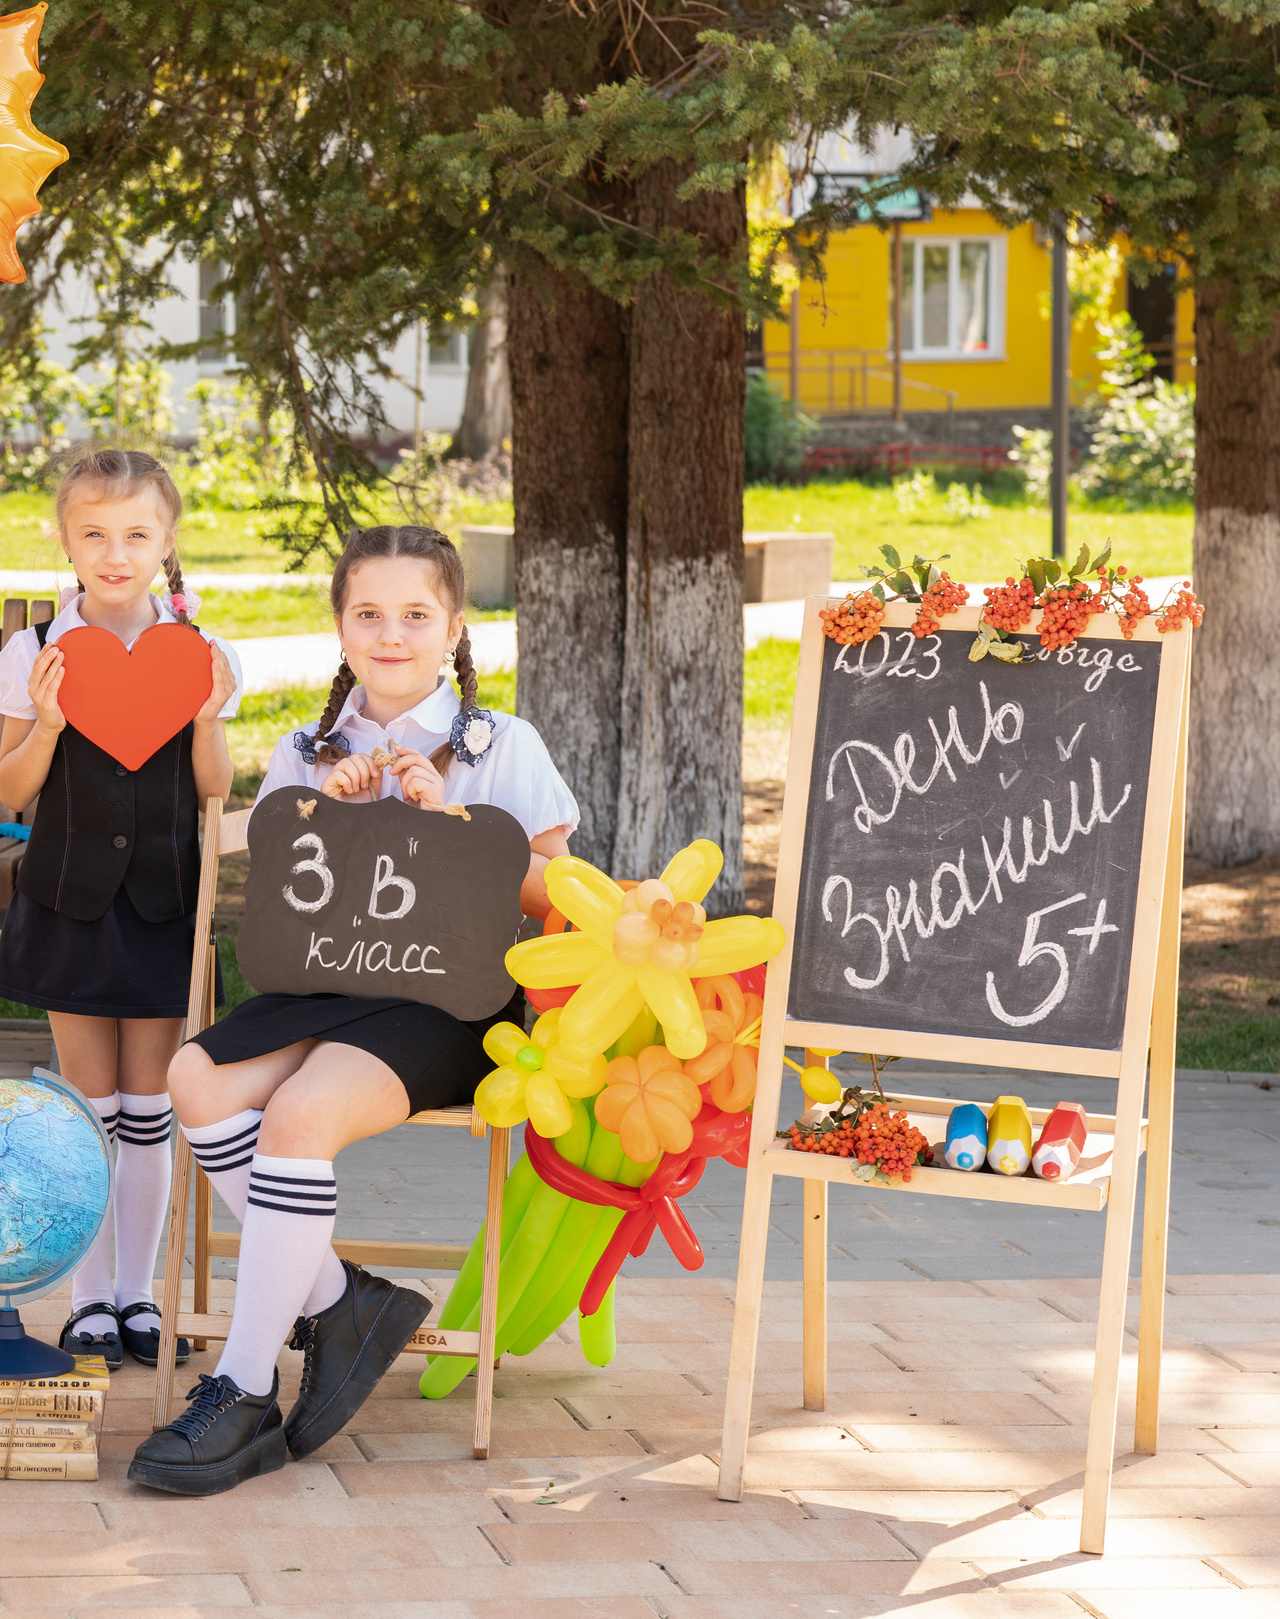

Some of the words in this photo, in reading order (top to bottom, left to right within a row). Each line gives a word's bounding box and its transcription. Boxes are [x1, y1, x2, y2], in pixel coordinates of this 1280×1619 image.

[825, 680, 1024, 833] День
[282, 832, 334, 913] 3
[985, 892, 1119, 1027] 5+
